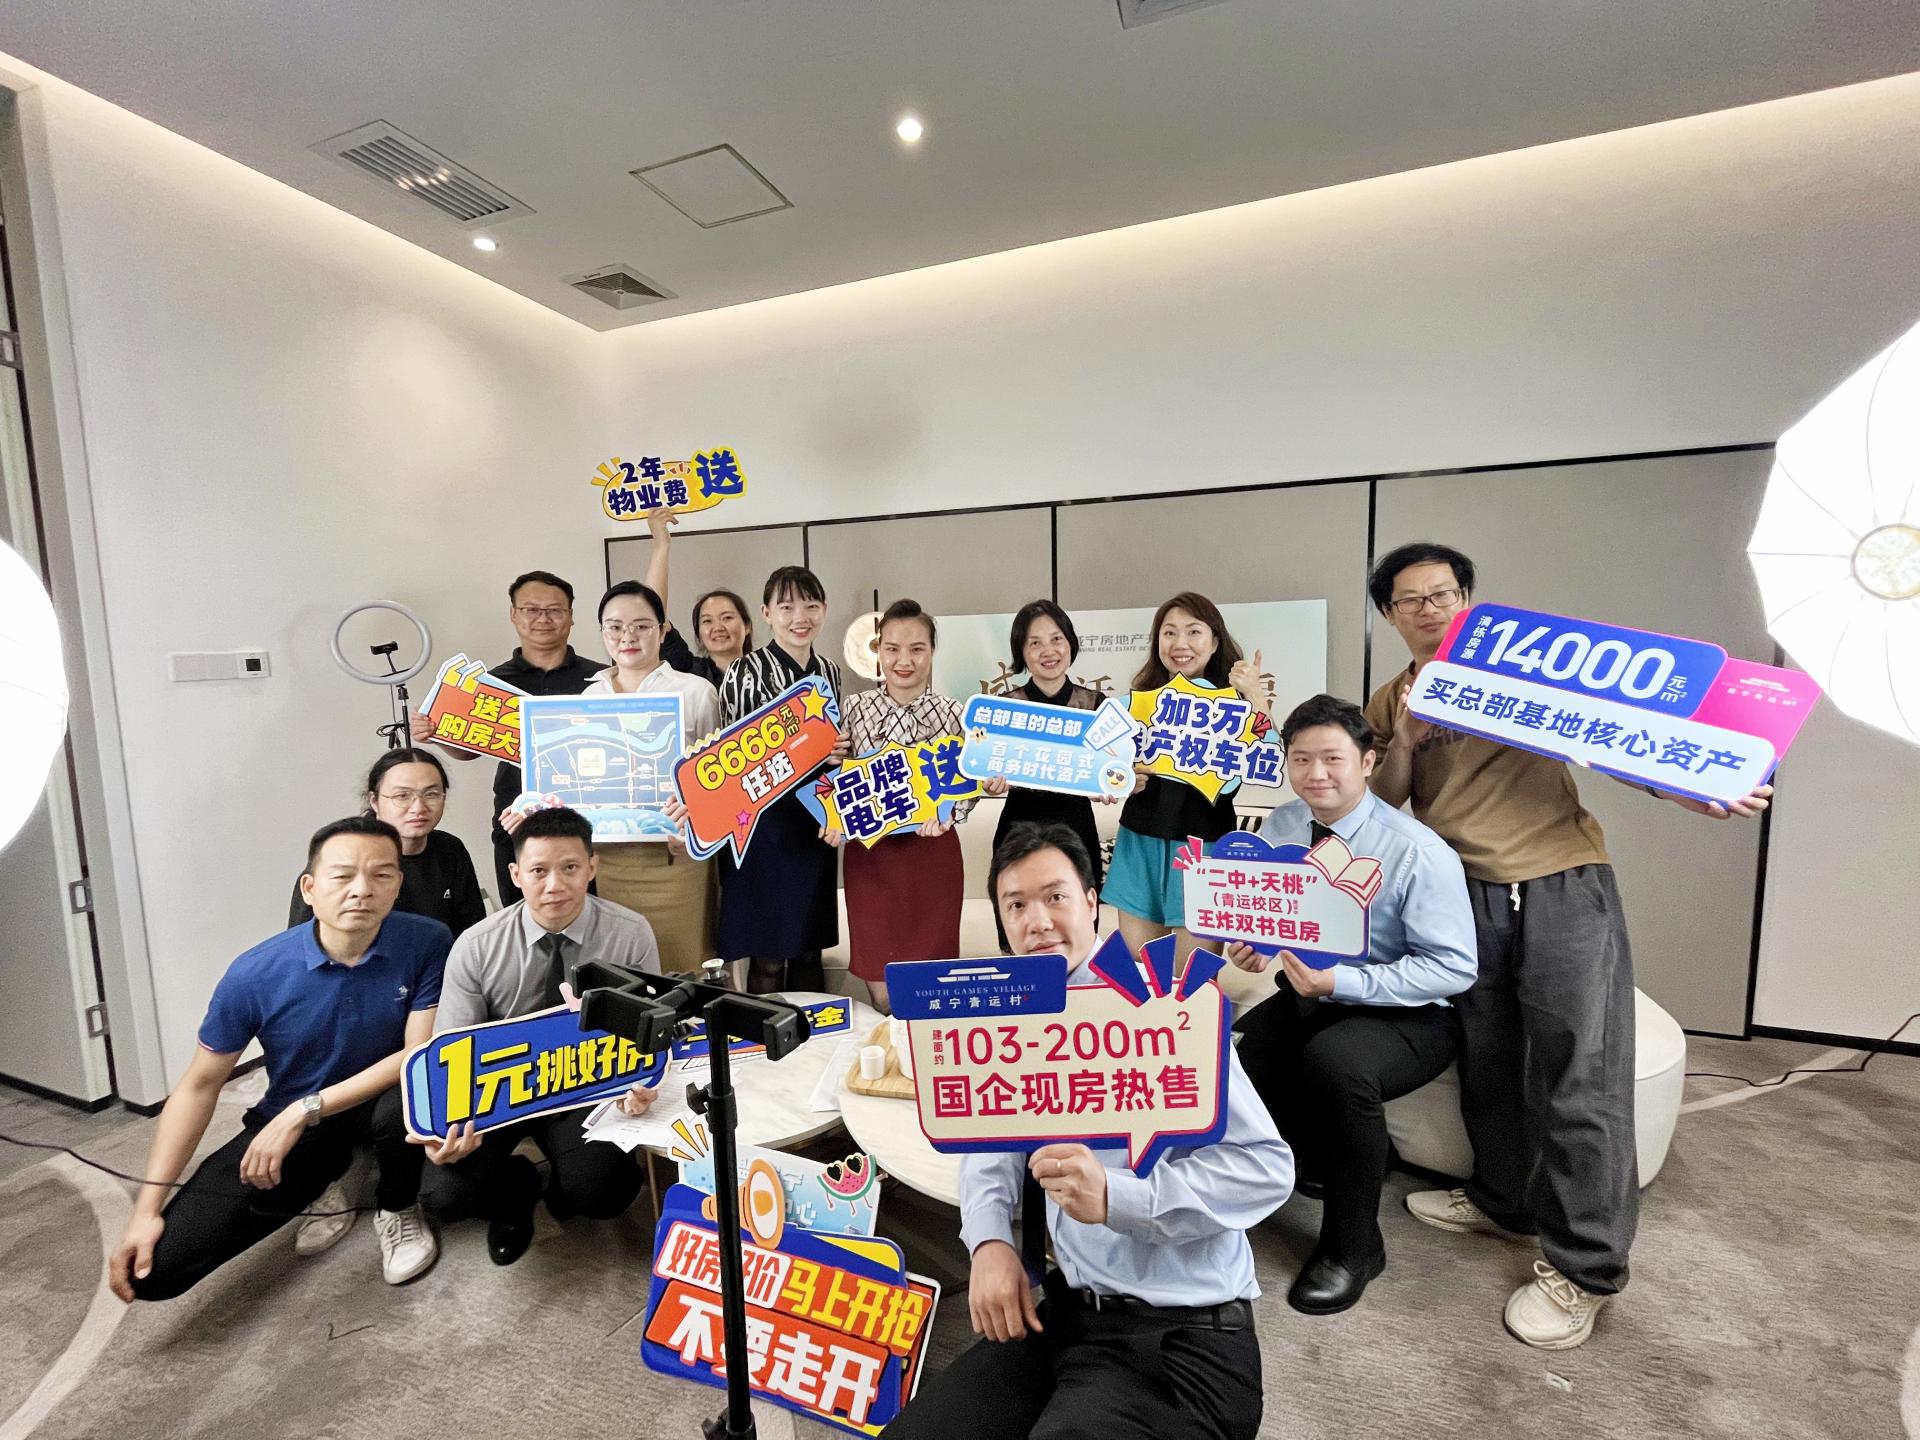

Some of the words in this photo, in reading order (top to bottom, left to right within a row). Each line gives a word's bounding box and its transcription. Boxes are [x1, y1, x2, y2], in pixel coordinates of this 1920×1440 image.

[619, 457, 665, 484] 2年
[695, 450, 744, 498] 送
[608, 479, 689, 515] 物业费
[1487, 619, 1676, 699] 14000
[435, 712, 520, 757] 购房大
[973, 706, 1083, 737] 总部里的总部
[1090, 716, 1120, 743] CALL
[1156, 694, 1246, 735] 加3万
[1423, 677, 1746, 774] 买总部基地核心资产
[696, 715, 786, 790] 6666
[918, 740, 978, 802] 送
[741, 751, 795, 803] 任选
[836, 753, 909, 809] 品牌
[844, 787, 916, 837] 电车
[1198, 909, 1320, 943] 王炸双书包房
[915, 989, 949, 997] YOUTH
[954, 987, 989, 995] GAMES
[993, 984, 1037, 992] VILLAGE
[929, 994, 1022, 1010] 咸宁青运村
[933, 1065, 1199, 1117] 国企现房热售
